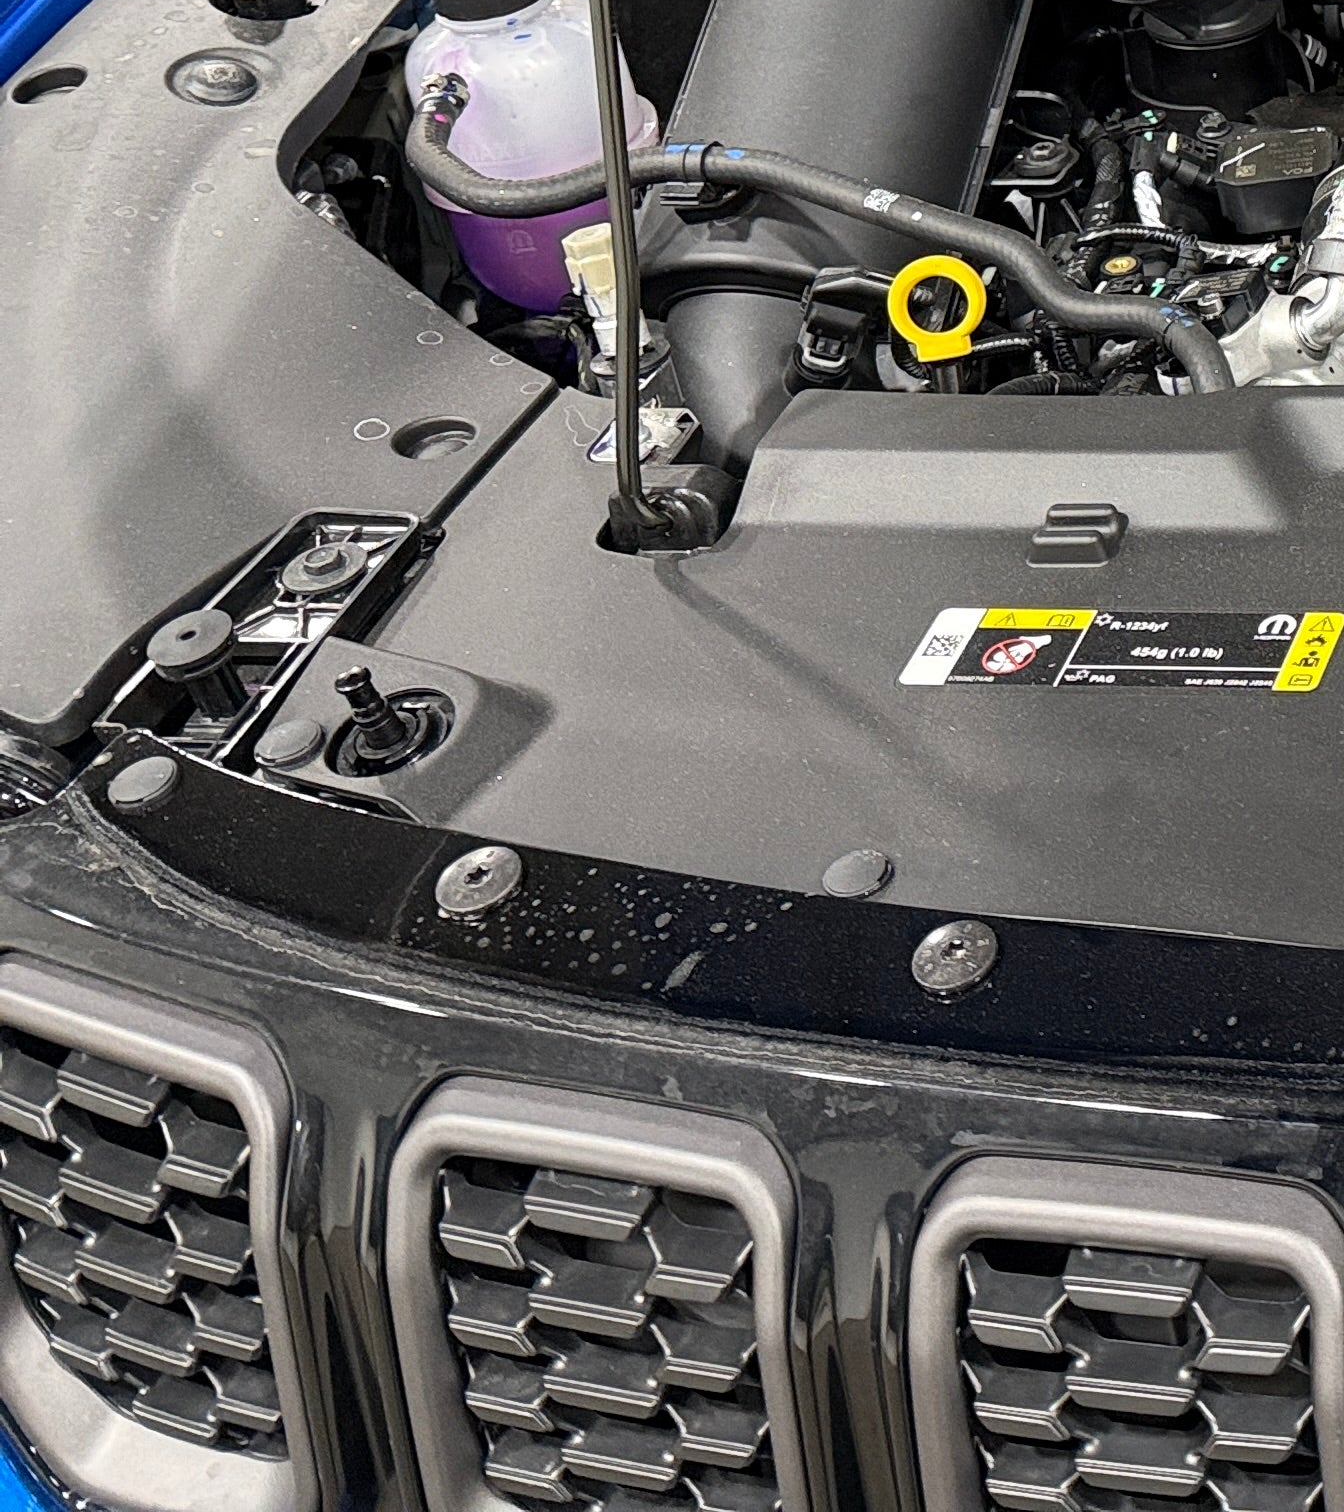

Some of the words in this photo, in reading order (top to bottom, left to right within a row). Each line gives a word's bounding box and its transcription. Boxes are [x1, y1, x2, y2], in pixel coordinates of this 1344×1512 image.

[1109, 621, 1169, 632] R-1234yf
[1130, 647, 1168, 659] 454g
[1170, 647, 1200, 659] (1.0
[1202, 647, 1224, 660] lb)
[1089, 675, 1116, 684] PAG
